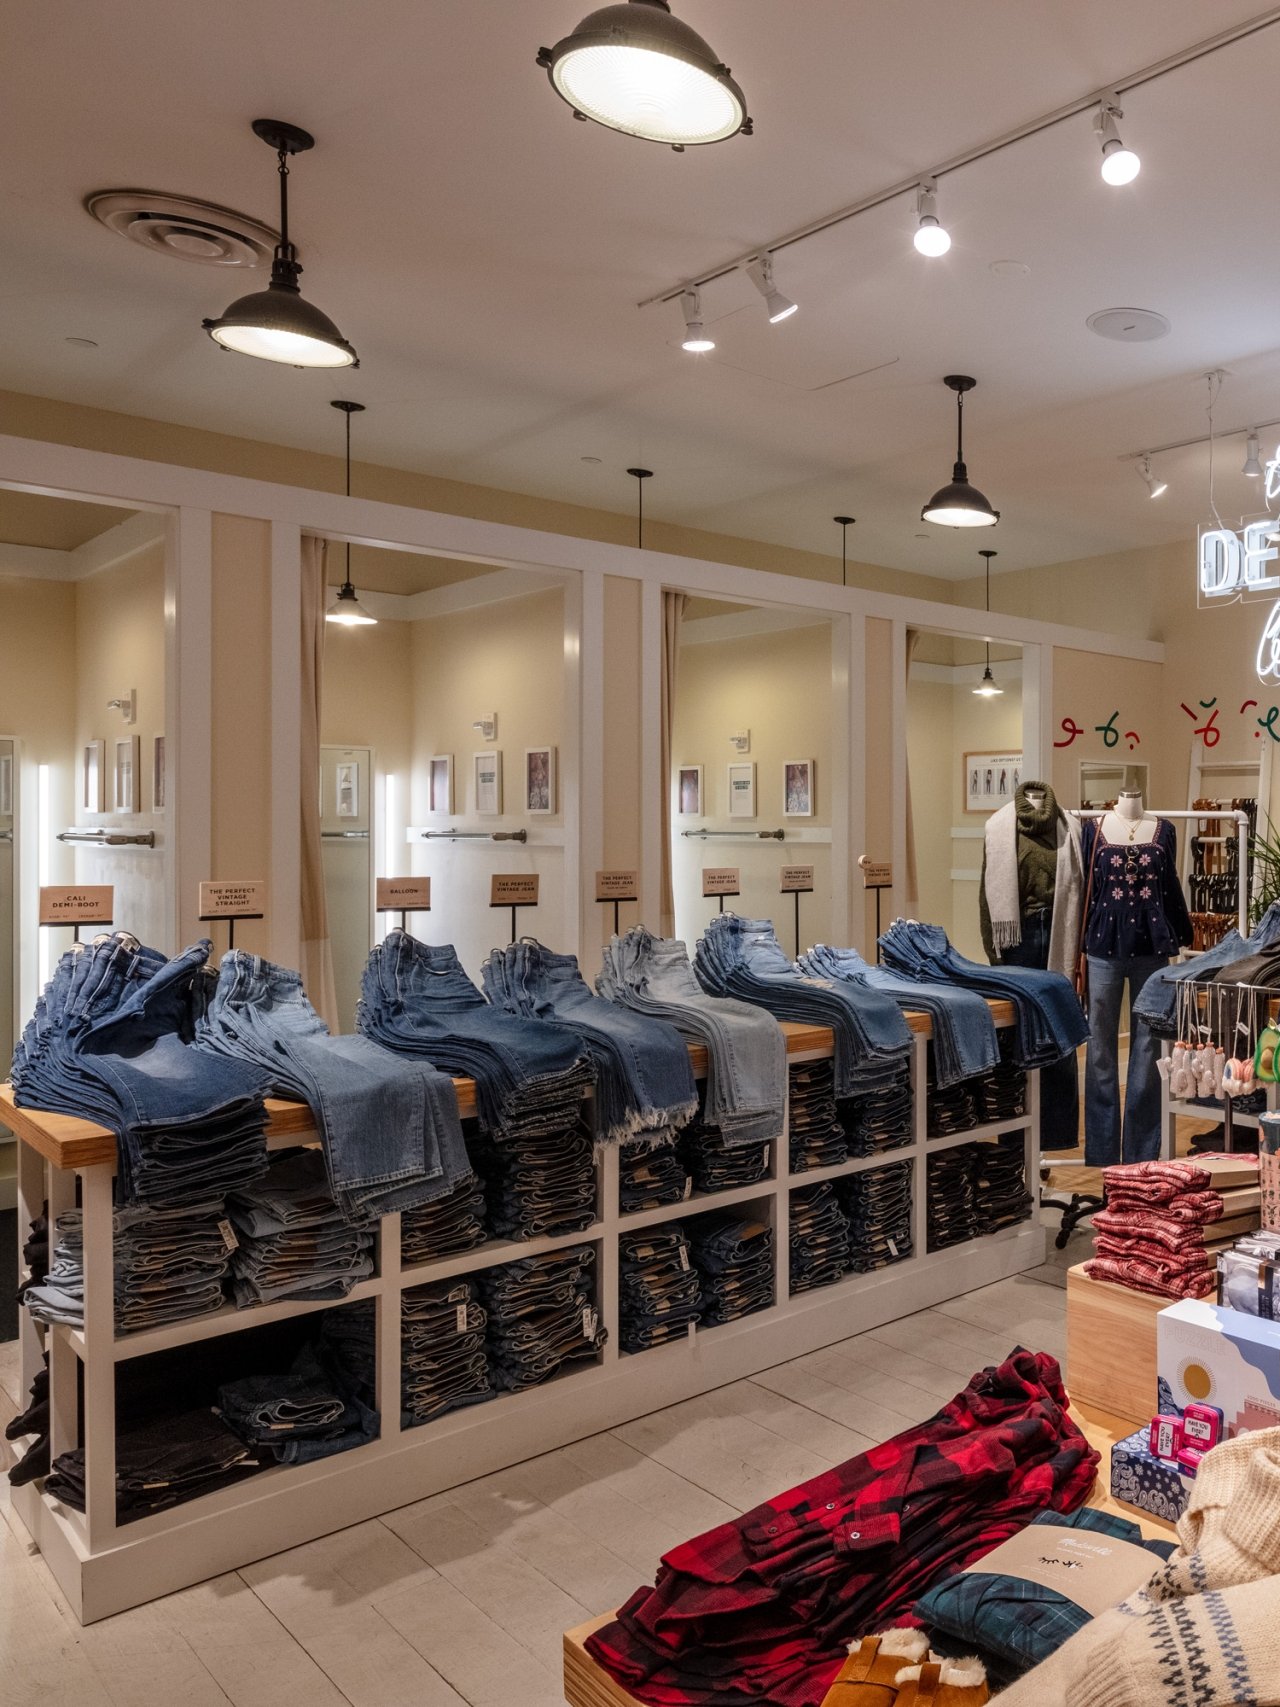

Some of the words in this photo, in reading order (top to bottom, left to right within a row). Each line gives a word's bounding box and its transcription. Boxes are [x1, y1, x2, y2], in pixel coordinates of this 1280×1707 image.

[1188, 1420, 1199, 1428] HAVE
[1198, 1422, 1208, 1430] YOU
[1191, 1427, 1204, 1435] EVER?
